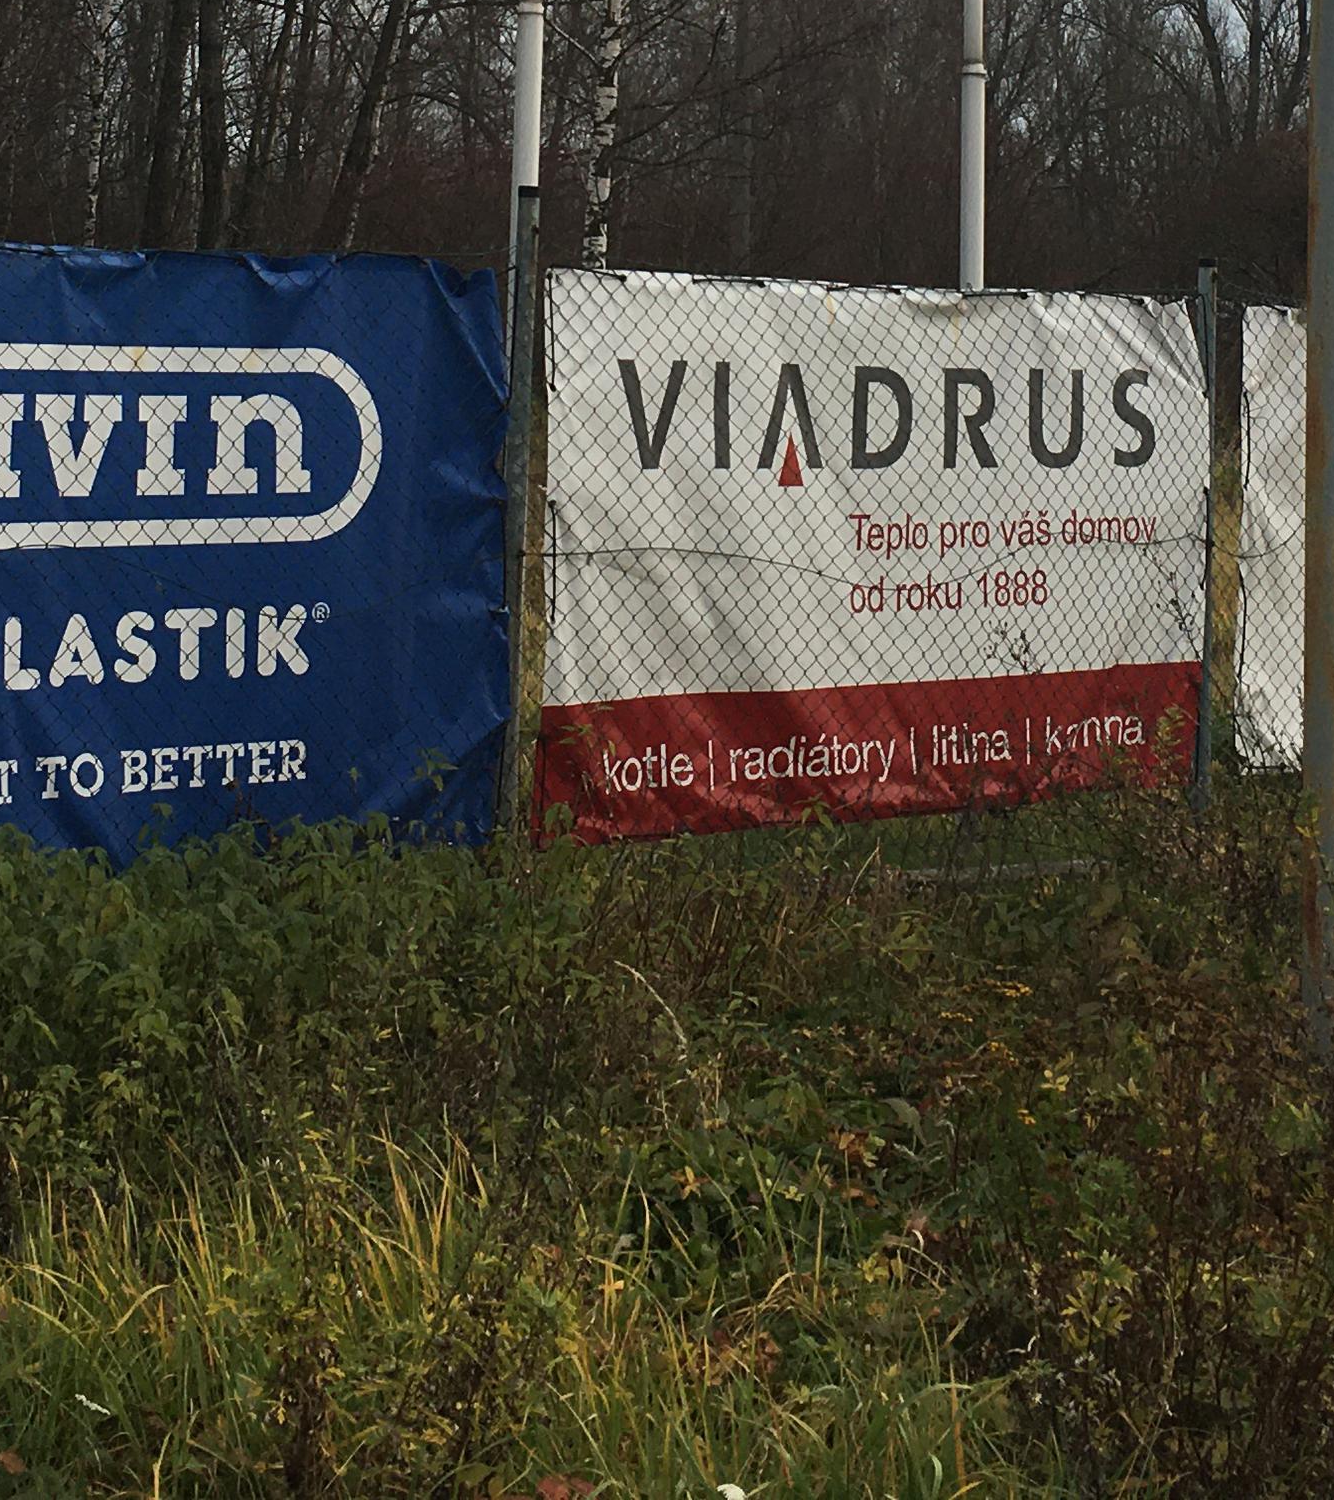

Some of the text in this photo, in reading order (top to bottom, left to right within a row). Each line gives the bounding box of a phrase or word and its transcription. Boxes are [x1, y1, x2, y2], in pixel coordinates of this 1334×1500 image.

[617, 359, 1157, 471] VIADRUS
[849, 509, 1157, 559] Teplo pro váš domov
[849, 570, 1049, 614] od roku 1888
[36, 753, 104, 802] TO
[119, 740, 307, 794] BETTER
[604, 744, 694, 795] kotle
[729, 733, 896, 783] radiátory
